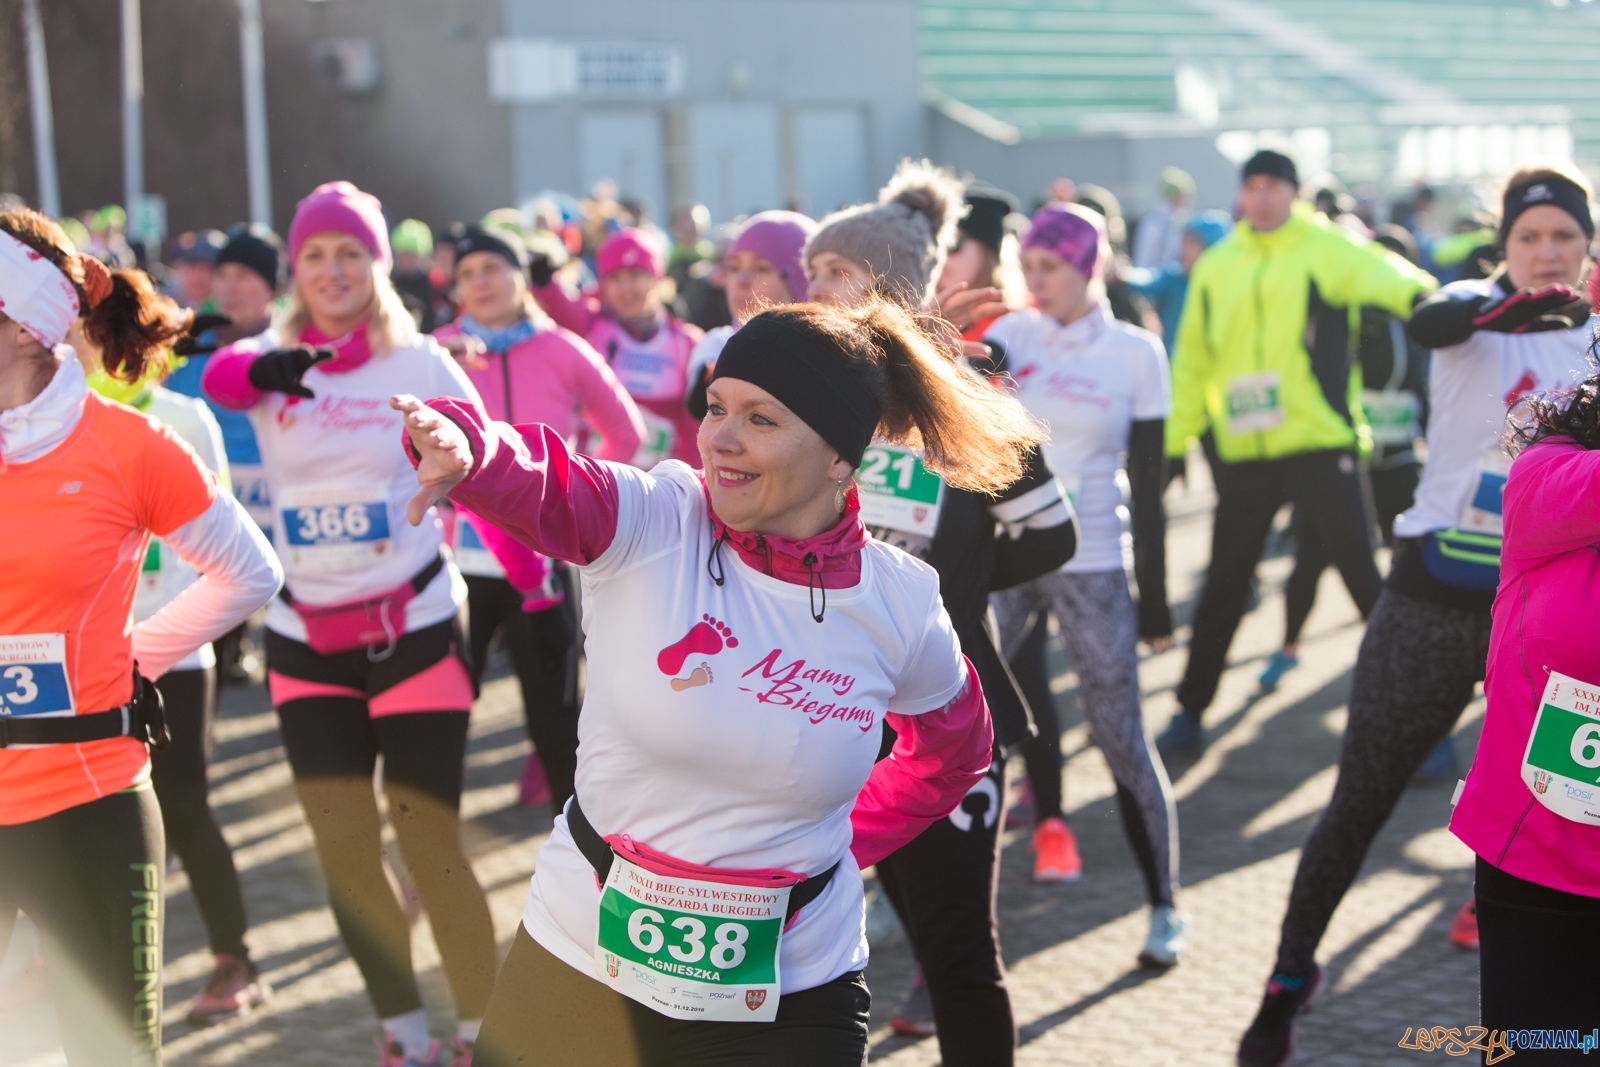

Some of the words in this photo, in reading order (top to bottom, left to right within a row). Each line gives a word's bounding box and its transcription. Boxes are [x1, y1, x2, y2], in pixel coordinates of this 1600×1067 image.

[297, 503, 370, 540] 366
[741, 648, 856, 696] Mamy
[1574, 701, 1591, 714] IM.
[629, 870, 653, 889] XXXII
[656, 883, 685, 896] BIEG
[688, 887, 780, 904] SYLWESTROWY
[629, 885, 642, 899] IM.
[645, 892, 709, 912] RYSZARDA
[712, 904, 771, 916] BURGIELA
[627, 908, 750, 970] 638
[647, 957, 721, 982] AGNIESZKA
[674, 1004, 705, 1012] 31.12.2016
